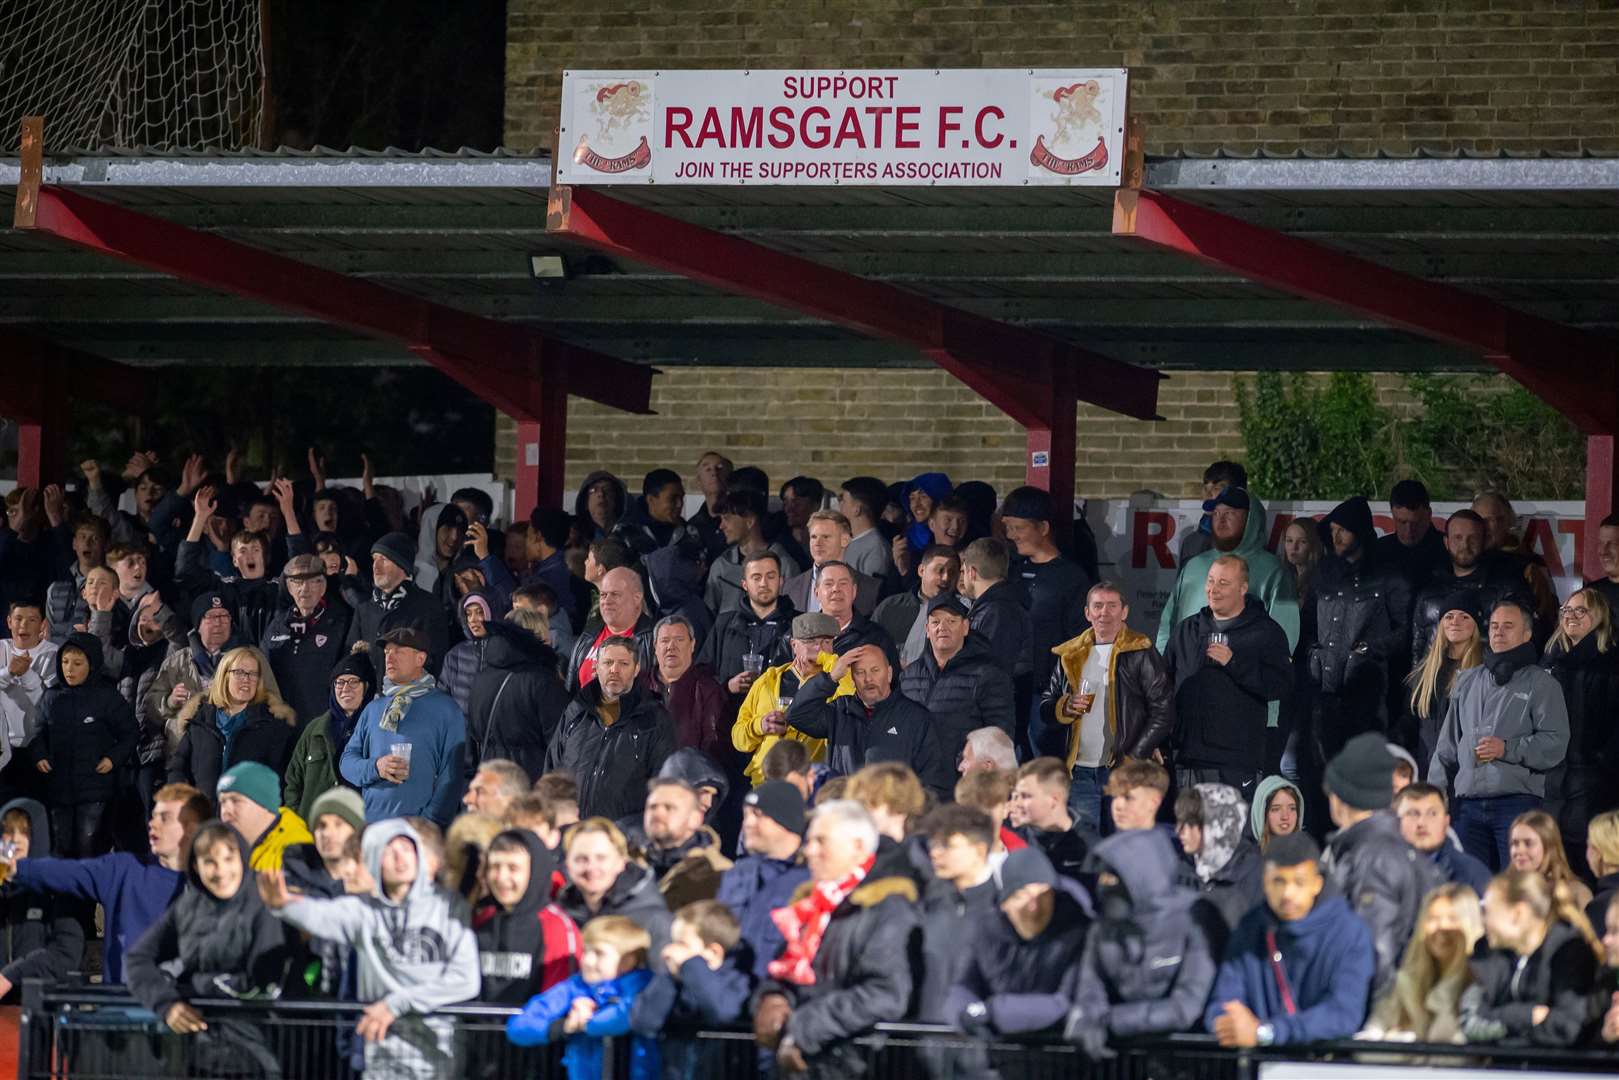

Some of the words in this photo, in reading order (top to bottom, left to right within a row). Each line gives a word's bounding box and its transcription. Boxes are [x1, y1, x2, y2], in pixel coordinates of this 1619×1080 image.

[783, 76, 898, 99] SUPPORT
[664, 106, 921, 149] RAMSGATE
[937, 106, 1018, 149] F.C.
[675, 162, 717, 179] JOIN
[719, 162, 755, 179] THE
[758, 162, 878, 179] SUPPORTERS
[881, 161, 1003, 178] ASSOCIATION
